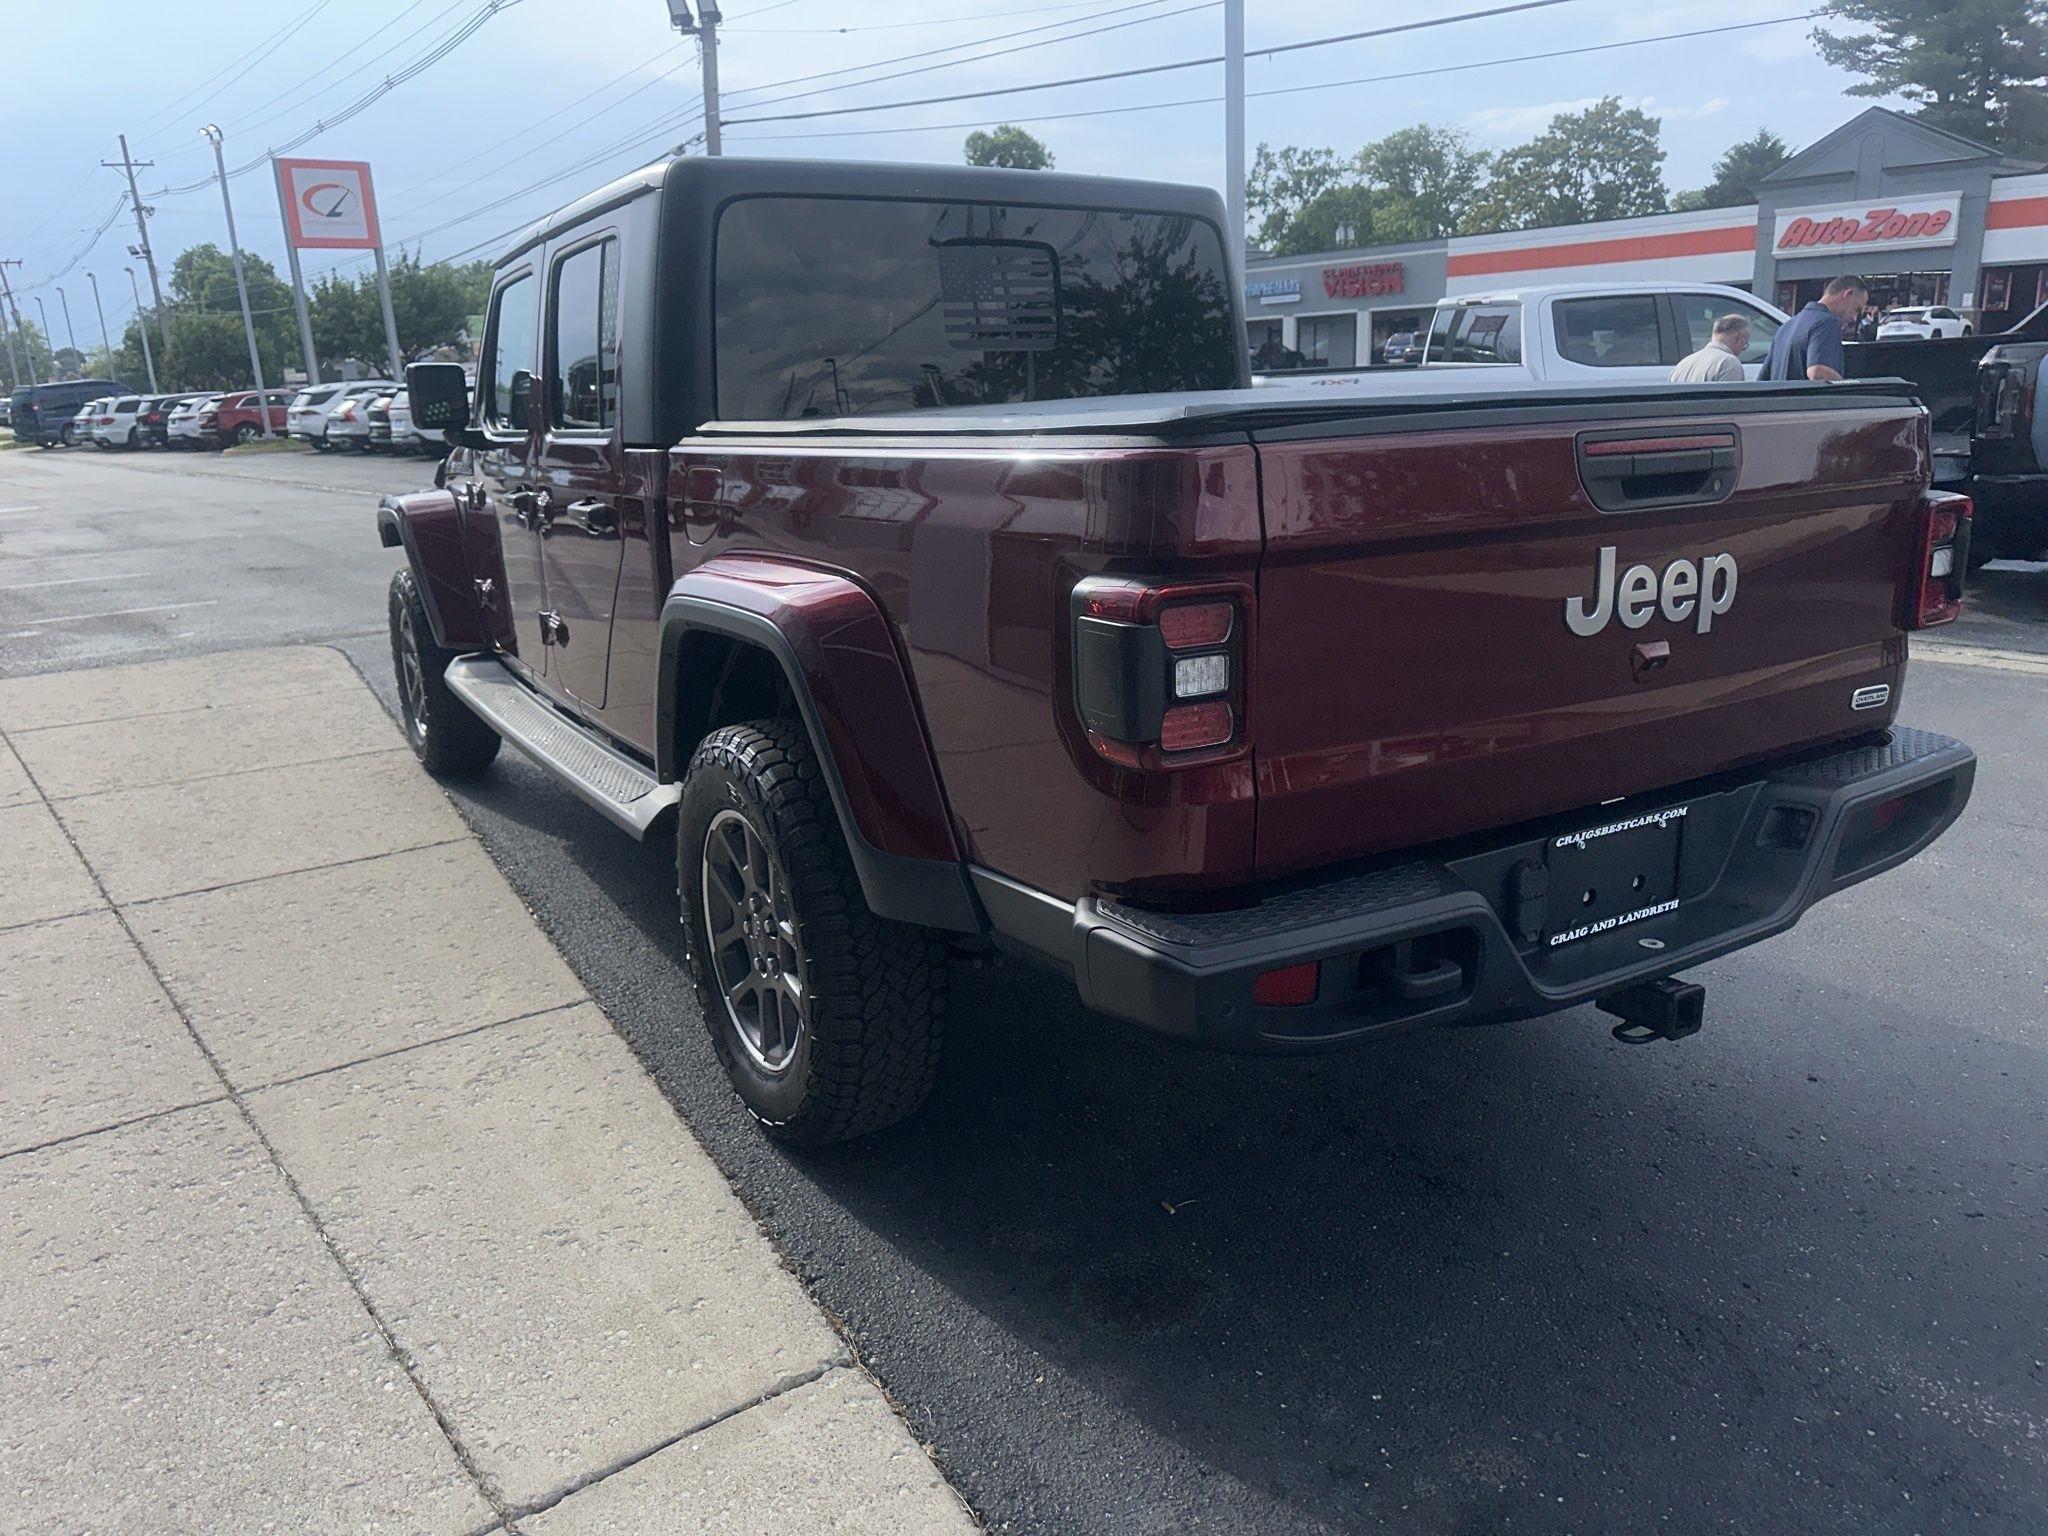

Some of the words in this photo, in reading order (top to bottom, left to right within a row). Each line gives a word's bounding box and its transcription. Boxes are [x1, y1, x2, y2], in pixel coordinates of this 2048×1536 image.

[1777, 208, 1951, 249] AutoZone
[1323, 276, 1405, 299] VISION
[1565, 546, 1738, 637] Jeep
[1556, 806, 1688, 847] CRAIGSBESTCARS.COM
[1550, 926, 1589, 946] CRAIG
[1590, 918, 1617, 934] AND
[1618, 899, 1680, 925] LANDRETH
